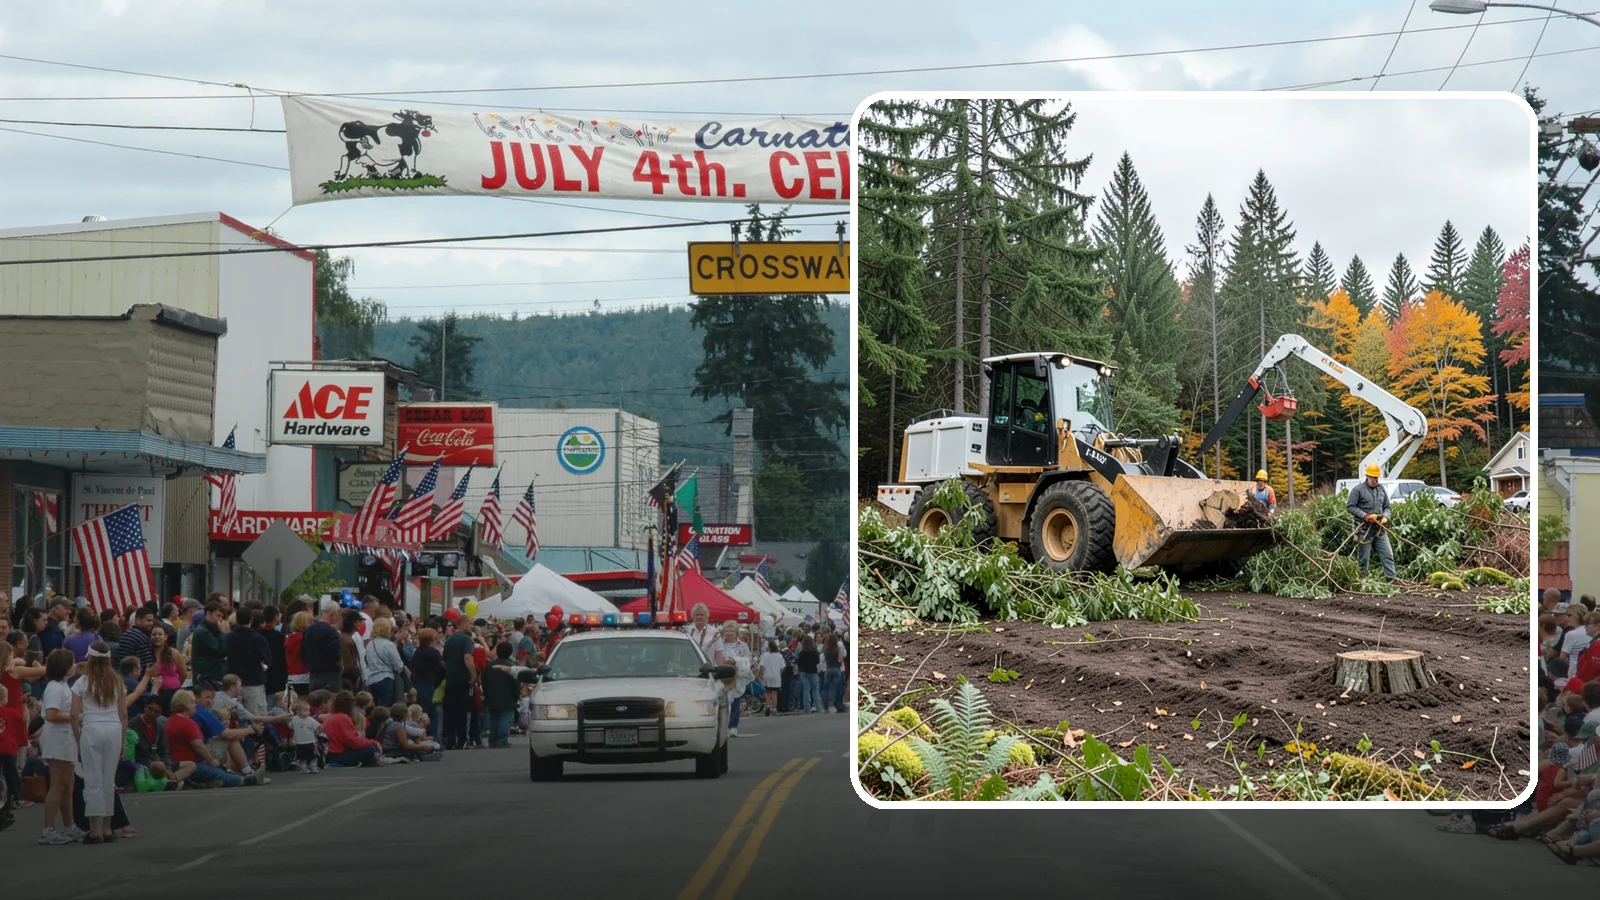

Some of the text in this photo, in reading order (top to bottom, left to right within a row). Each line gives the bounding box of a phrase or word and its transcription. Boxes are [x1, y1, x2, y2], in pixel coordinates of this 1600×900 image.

[695, 121, 850, 150] Carnat
[481, 141, 605, 192] JULY
[632, 150, 746, 197] 4th.
[697, 254, 850, 280] CROSSWA
[283, 380, 373, 420] ACE
[406, 409, 453, 422] CEDAR
[284, 421, 371, 437] Hardware
[95, 485, 124, 495] Vincent
[126, 486, 136, 495] de
[138, 486, 155, 495] Paul
[688, 526, 741, 535] CRNATION
[699, 535, 730, 543] GLASS
